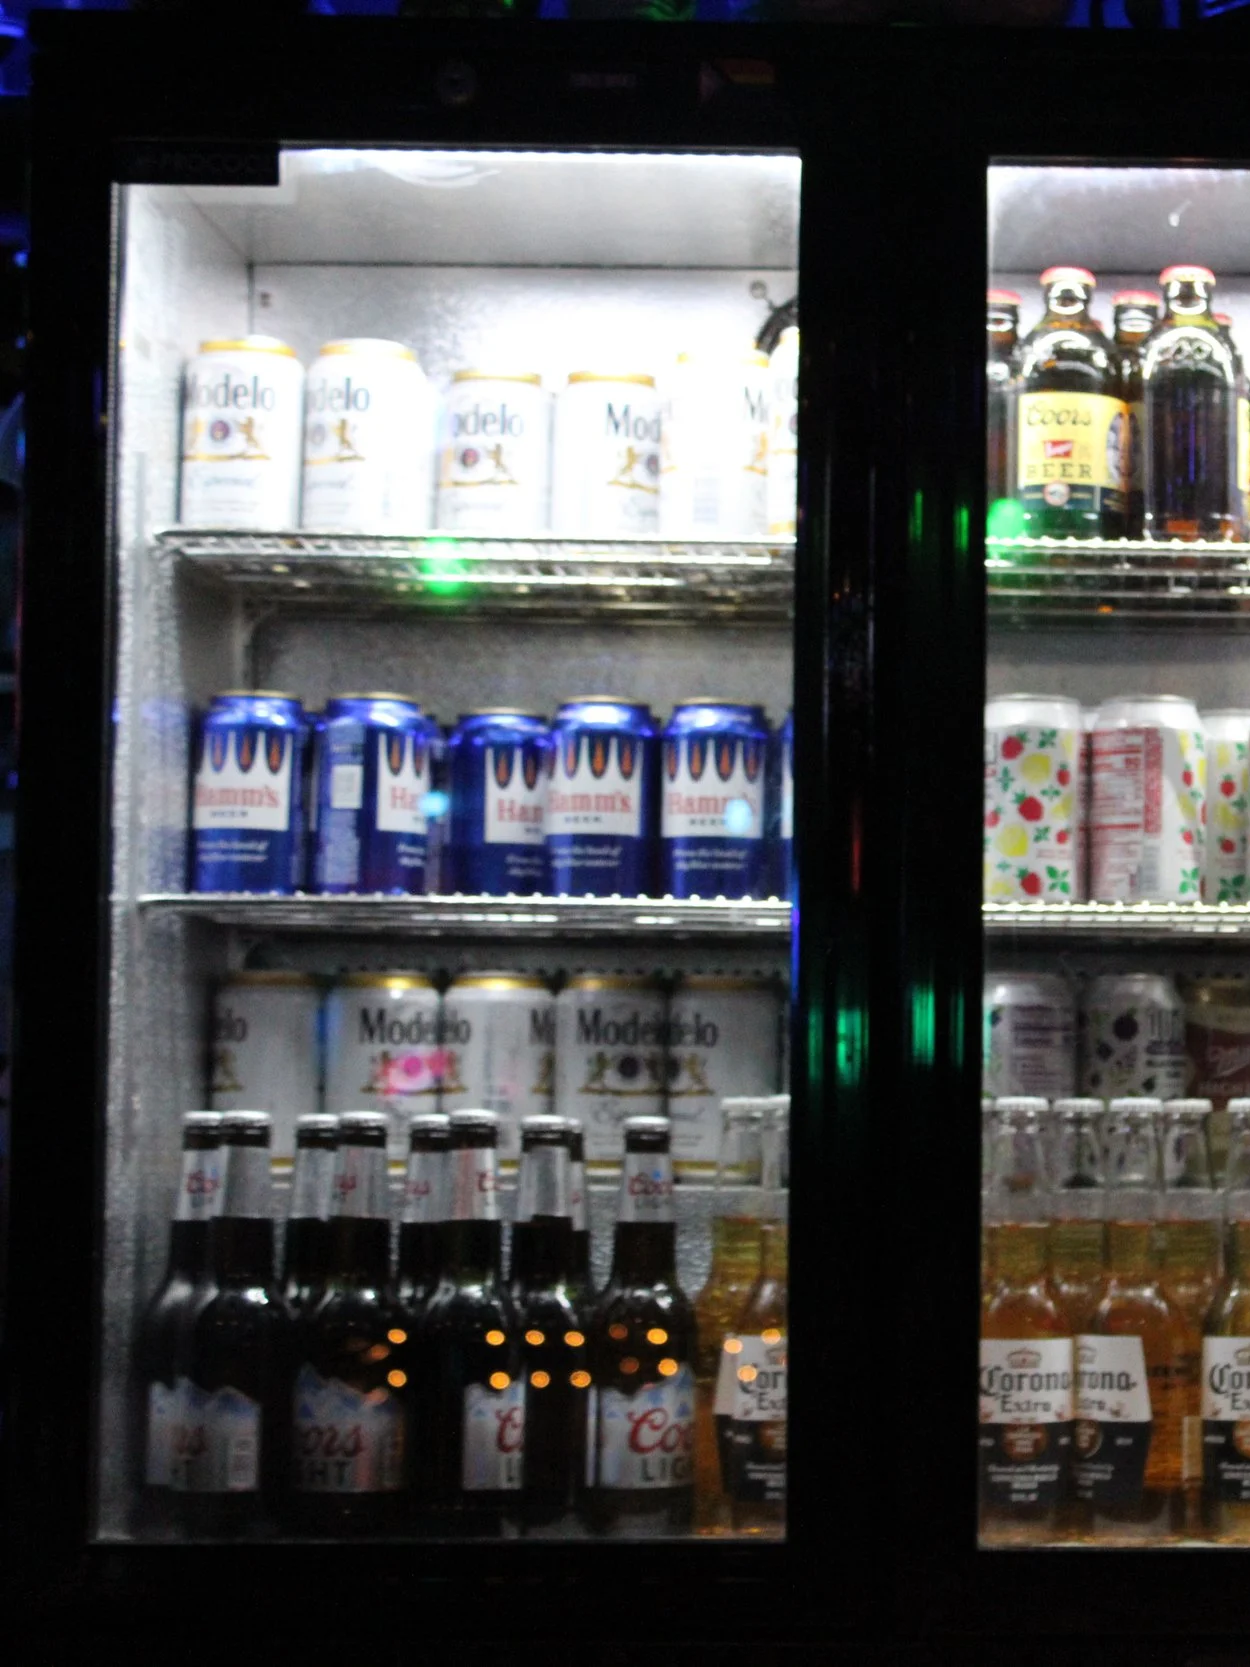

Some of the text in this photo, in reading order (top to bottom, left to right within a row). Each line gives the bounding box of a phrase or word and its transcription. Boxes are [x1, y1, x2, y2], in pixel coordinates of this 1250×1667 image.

[188, 372, 276, 411] odelo
[1026, 463, 1092, 480] BEER
[1001, 1395, 1052, 1413] Extra
